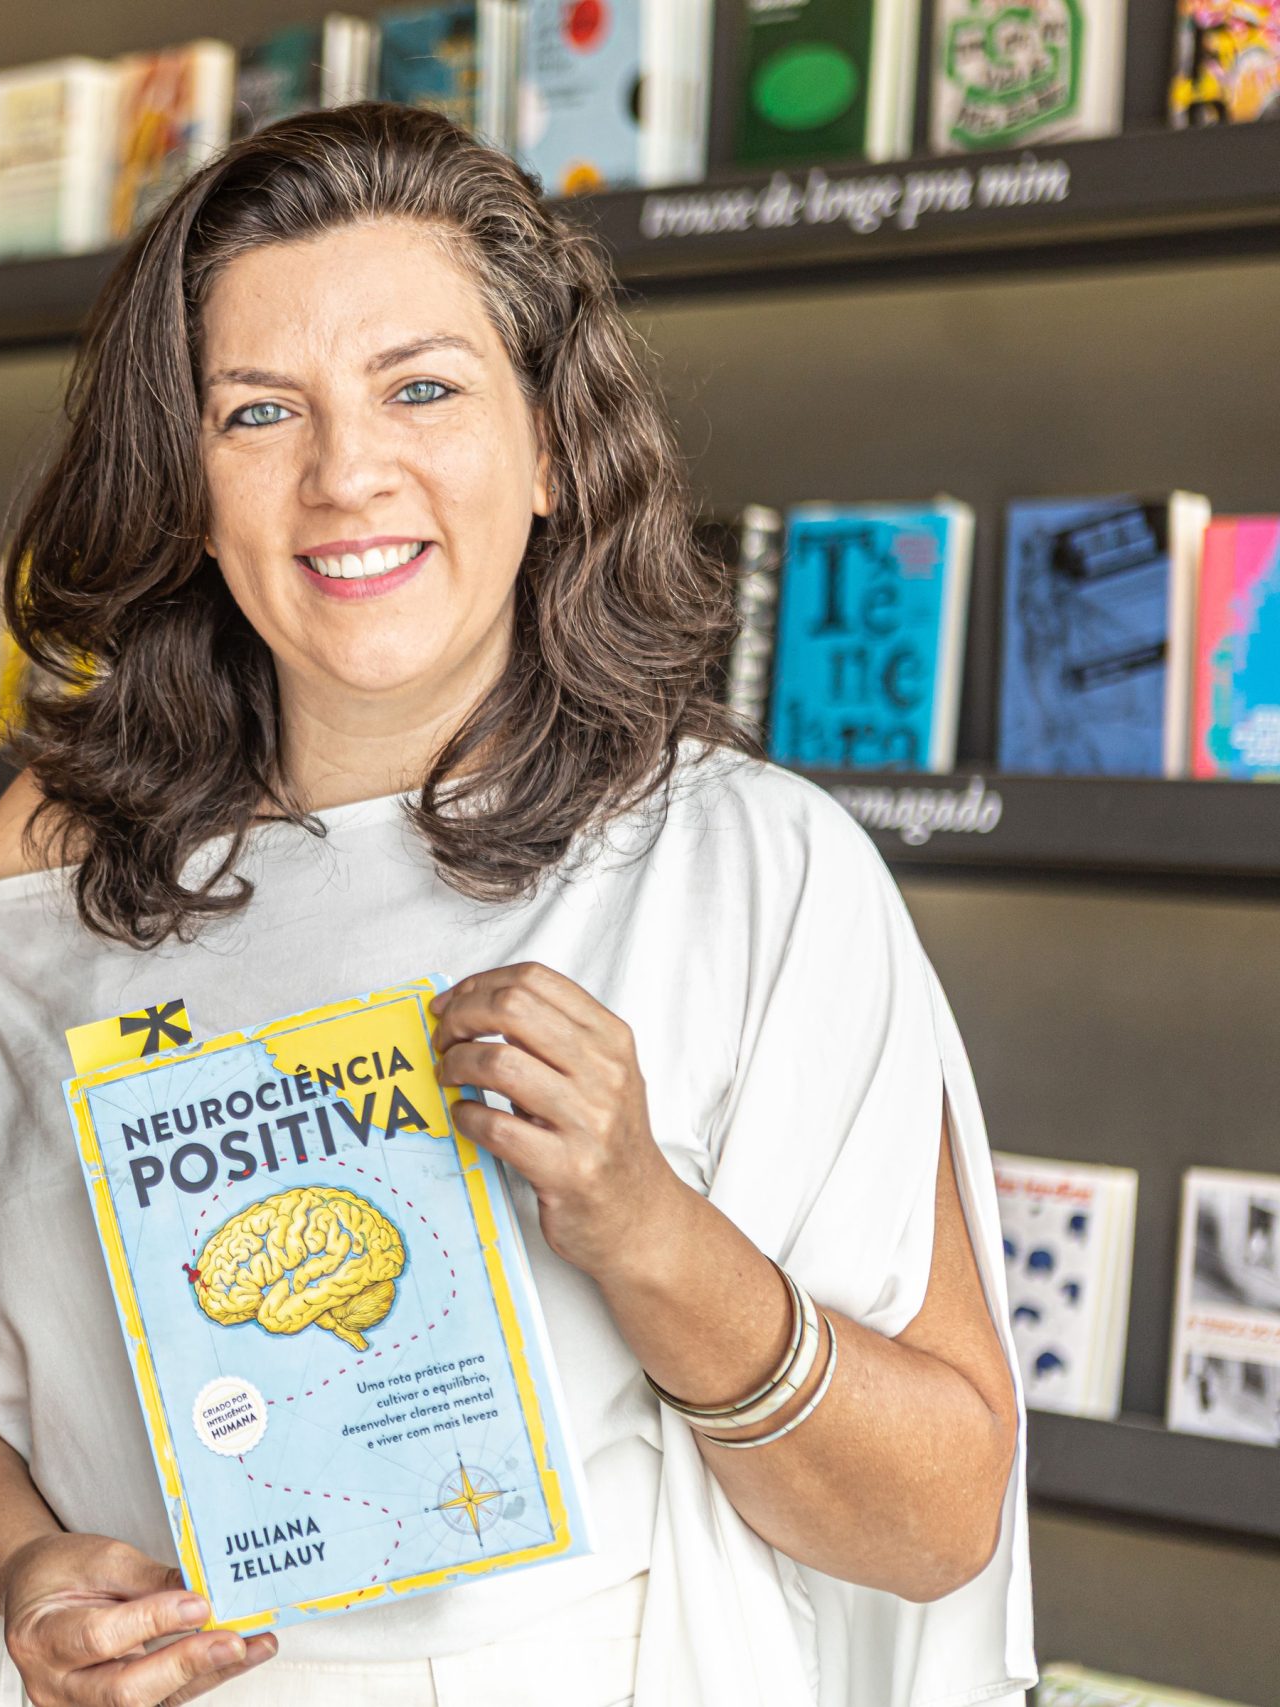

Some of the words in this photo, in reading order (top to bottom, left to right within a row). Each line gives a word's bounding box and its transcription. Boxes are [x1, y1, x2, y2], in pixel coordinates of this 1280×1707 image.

[755, 170, 803, 229] de
[803, 166, 902, 234] longe
[897, 168, 973, 230] pra
[977, 150, 1070, 208] mim
[121, 1046, 414, 1151] NEUROCIÊNCIA
[129, 1085, 429, 1208] POSITIVA
[357, 1380, 385, 1394] Uma
[388, 1374, 412, 1387] rota
[415, 1363, 455, 1383] prática
[459, 1354, 485, 1372] para
[377, 1391, 419, 1408] cultivar
[422, 1388, 430, 1397] o
[433, 1372, 490, 1395] equilíbrio,
[202, 1401, 231, 1419] CRIADO
[232, 1392, 248, 1405] POR
[207, 1403, 253, 1427] INTELIGÊNCIA
[342, 1413, 407, 1437] desenvolver
[410, 1402, 450, 1419] clareza
[454, 1388, 494, 1408] mental
[211, 1412, 258, 1440] HUMANA
[367, 1440, 375, 1449] e
[377, 1433, 403, 1446] viver
[407, 1426, 431, 1439] com
[434, 1417, 460, 1432] mais
[463, 1408, 499, 1424] leveza
[225, 1516, 321, 1555] JULIANA
[230, 1541, 325, 1582] ZELLAUY
